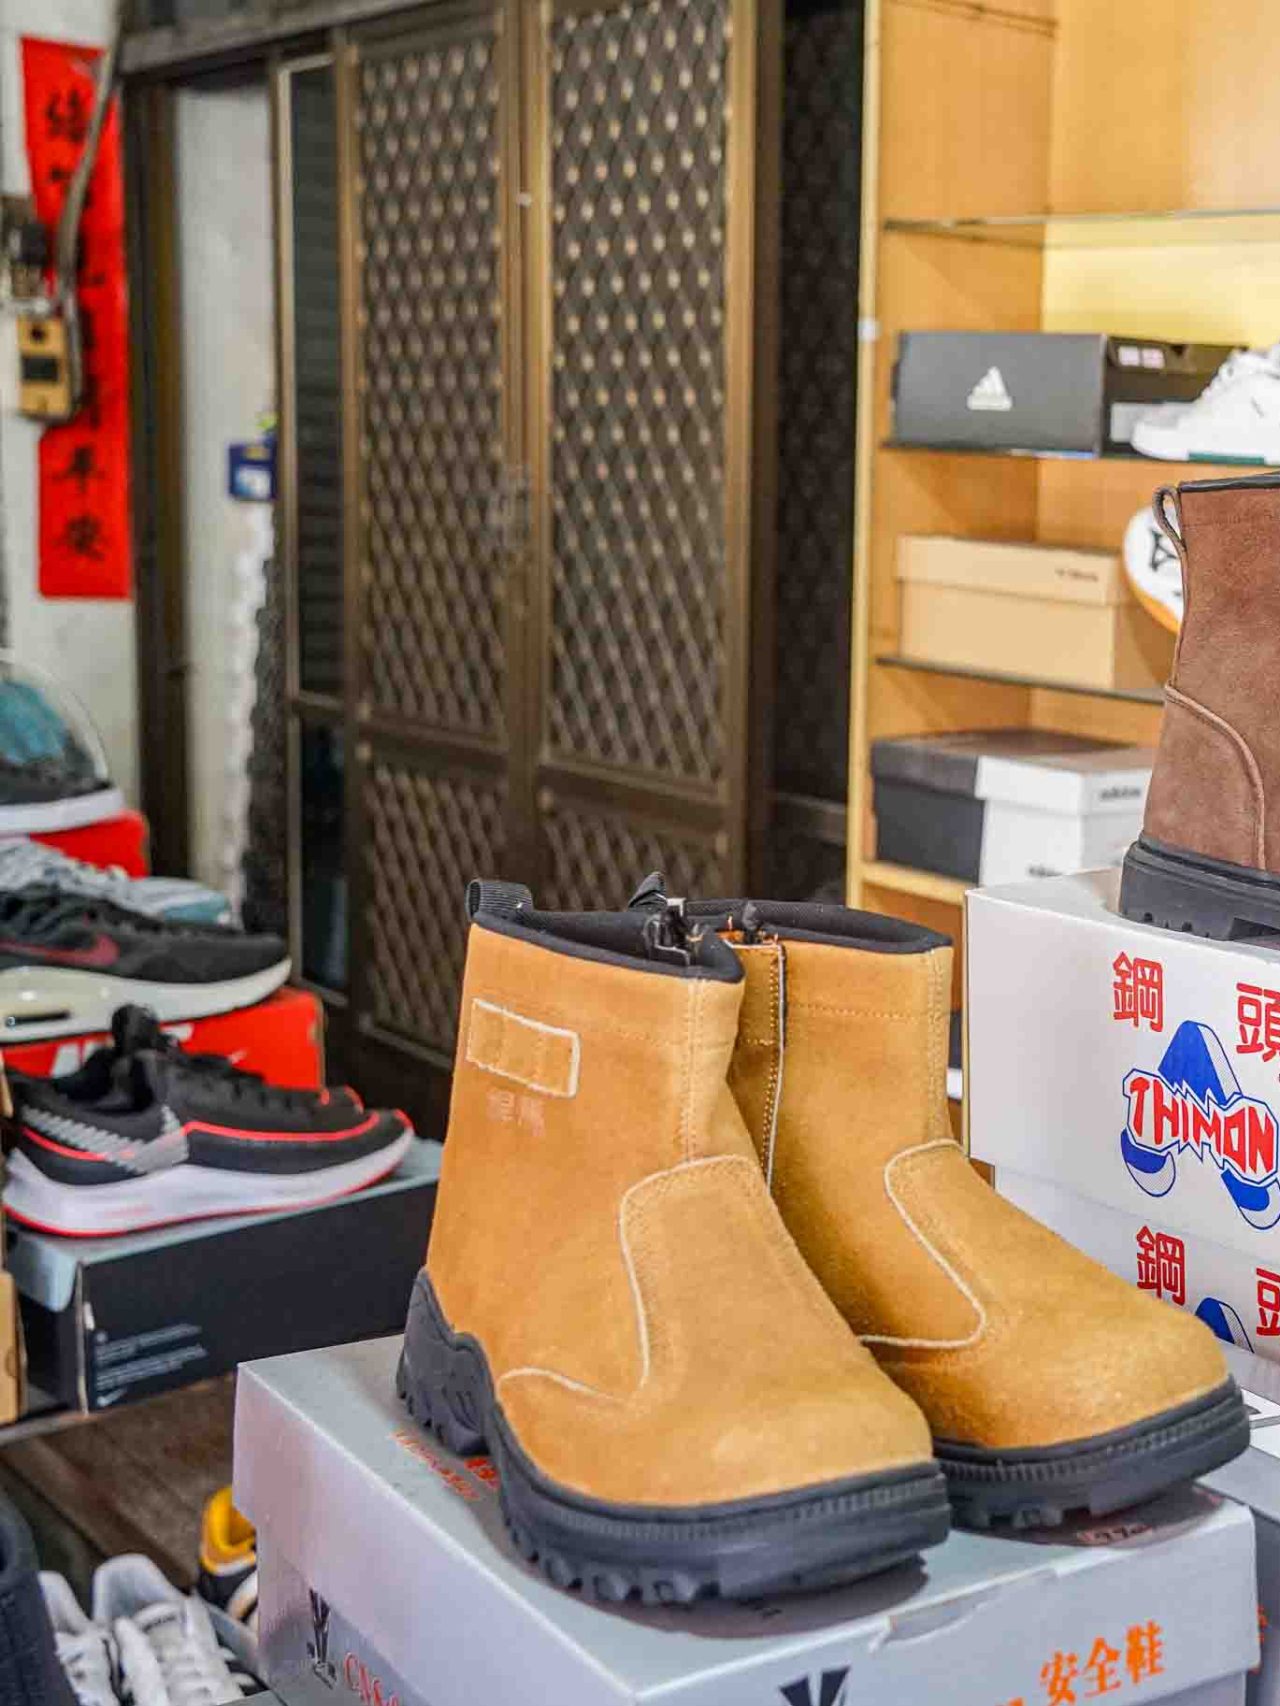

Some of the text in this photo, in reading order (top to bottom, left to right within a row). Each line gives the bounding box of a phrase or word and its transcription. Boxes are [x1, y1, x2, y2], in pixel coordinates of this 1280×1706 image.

[1113, 952, 1163, 1033] 鋼
[1129, 1077, 1274, 1173] THIMON
[1041, 1620, 1165, 1706] 安全鞋
